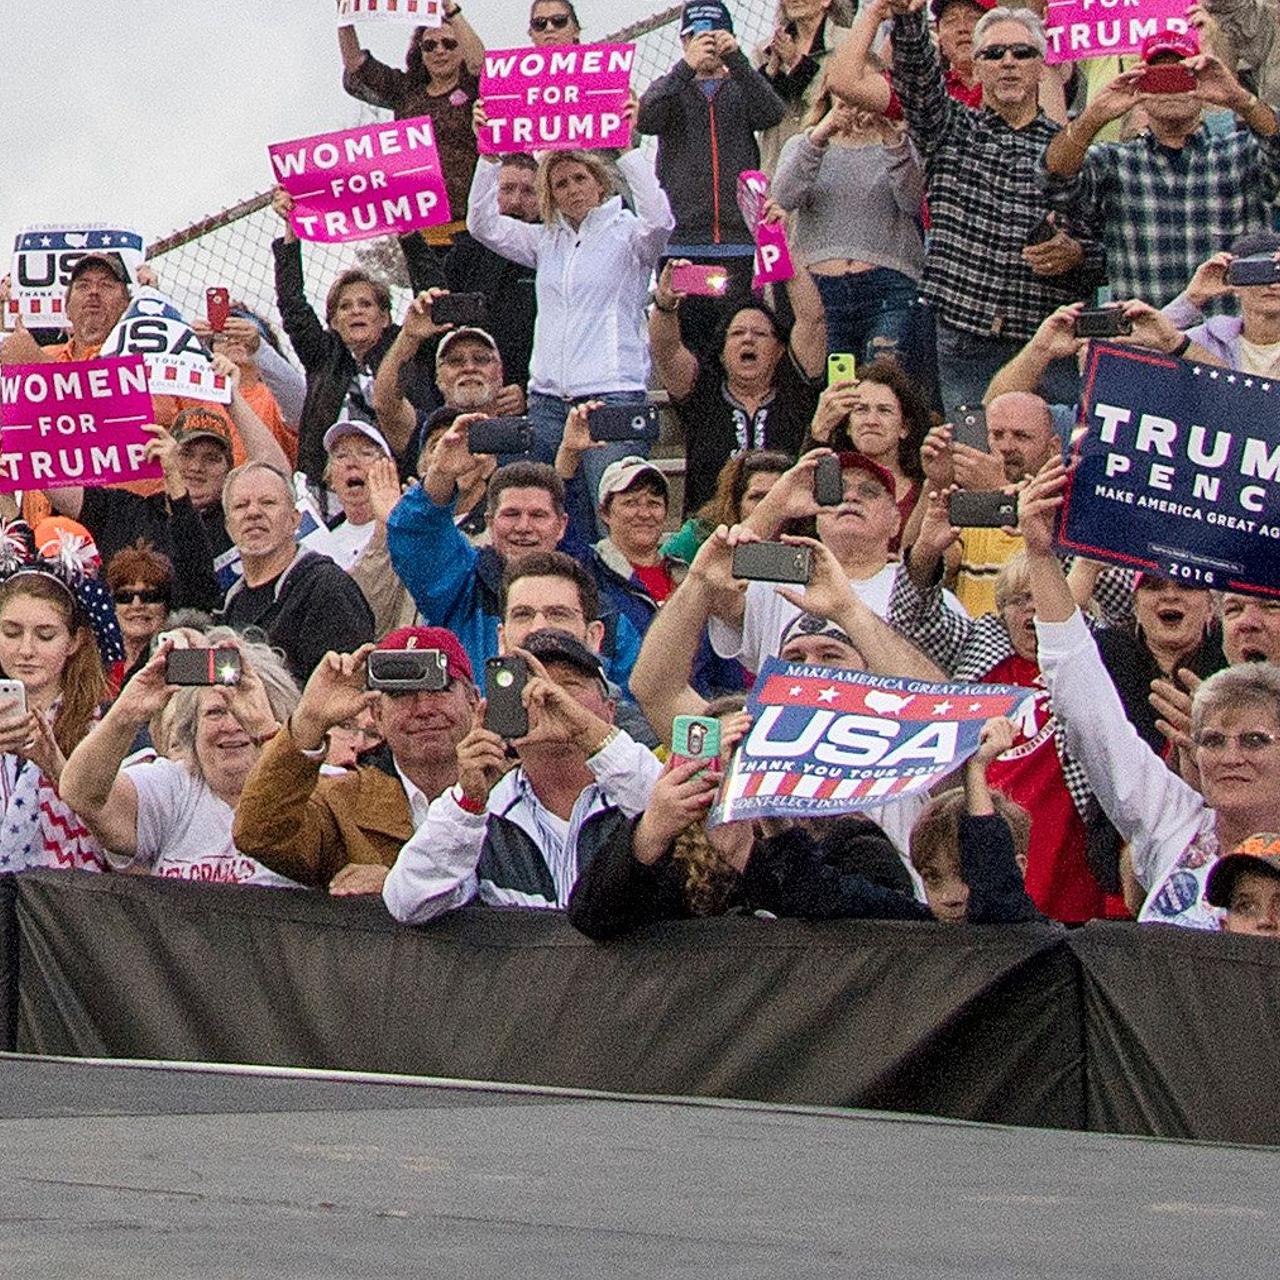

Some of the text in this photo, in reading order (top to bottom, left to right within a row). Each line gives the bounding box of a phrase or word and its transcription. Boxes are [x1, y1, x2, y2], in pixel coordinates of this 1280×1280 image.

[485, 51, 633, 78] WOMEN
[527, 86, 580, 105] FOR
[487, 113, 620, 144] TRUMP
[272, 123, 433, 178] WOMEN
[330, 170, 388, 198] FOR
[296, 190, 438, 236] TRUMP
[0, 365, 147, 404] WOMEN
[38, 414, 97, 436] FOR
[1, 444, 146, 481] TRUMP
[1095, 485, 1134, 504] MAKE
[1137, 495, 1202, 520] AMERICA
[1206, 511, 1255, 533] GREAT
[1169, 562, 1214, 583] 2016
[784, 665, 1010, 696] MAKE AMERICA GREAT AGAIN
[744, 705, 959, 767] USA
[739, 760, 797, 772] THANK
[802, 763, 841, 778] YOU
[851, 767, 897, 780] TOUR
